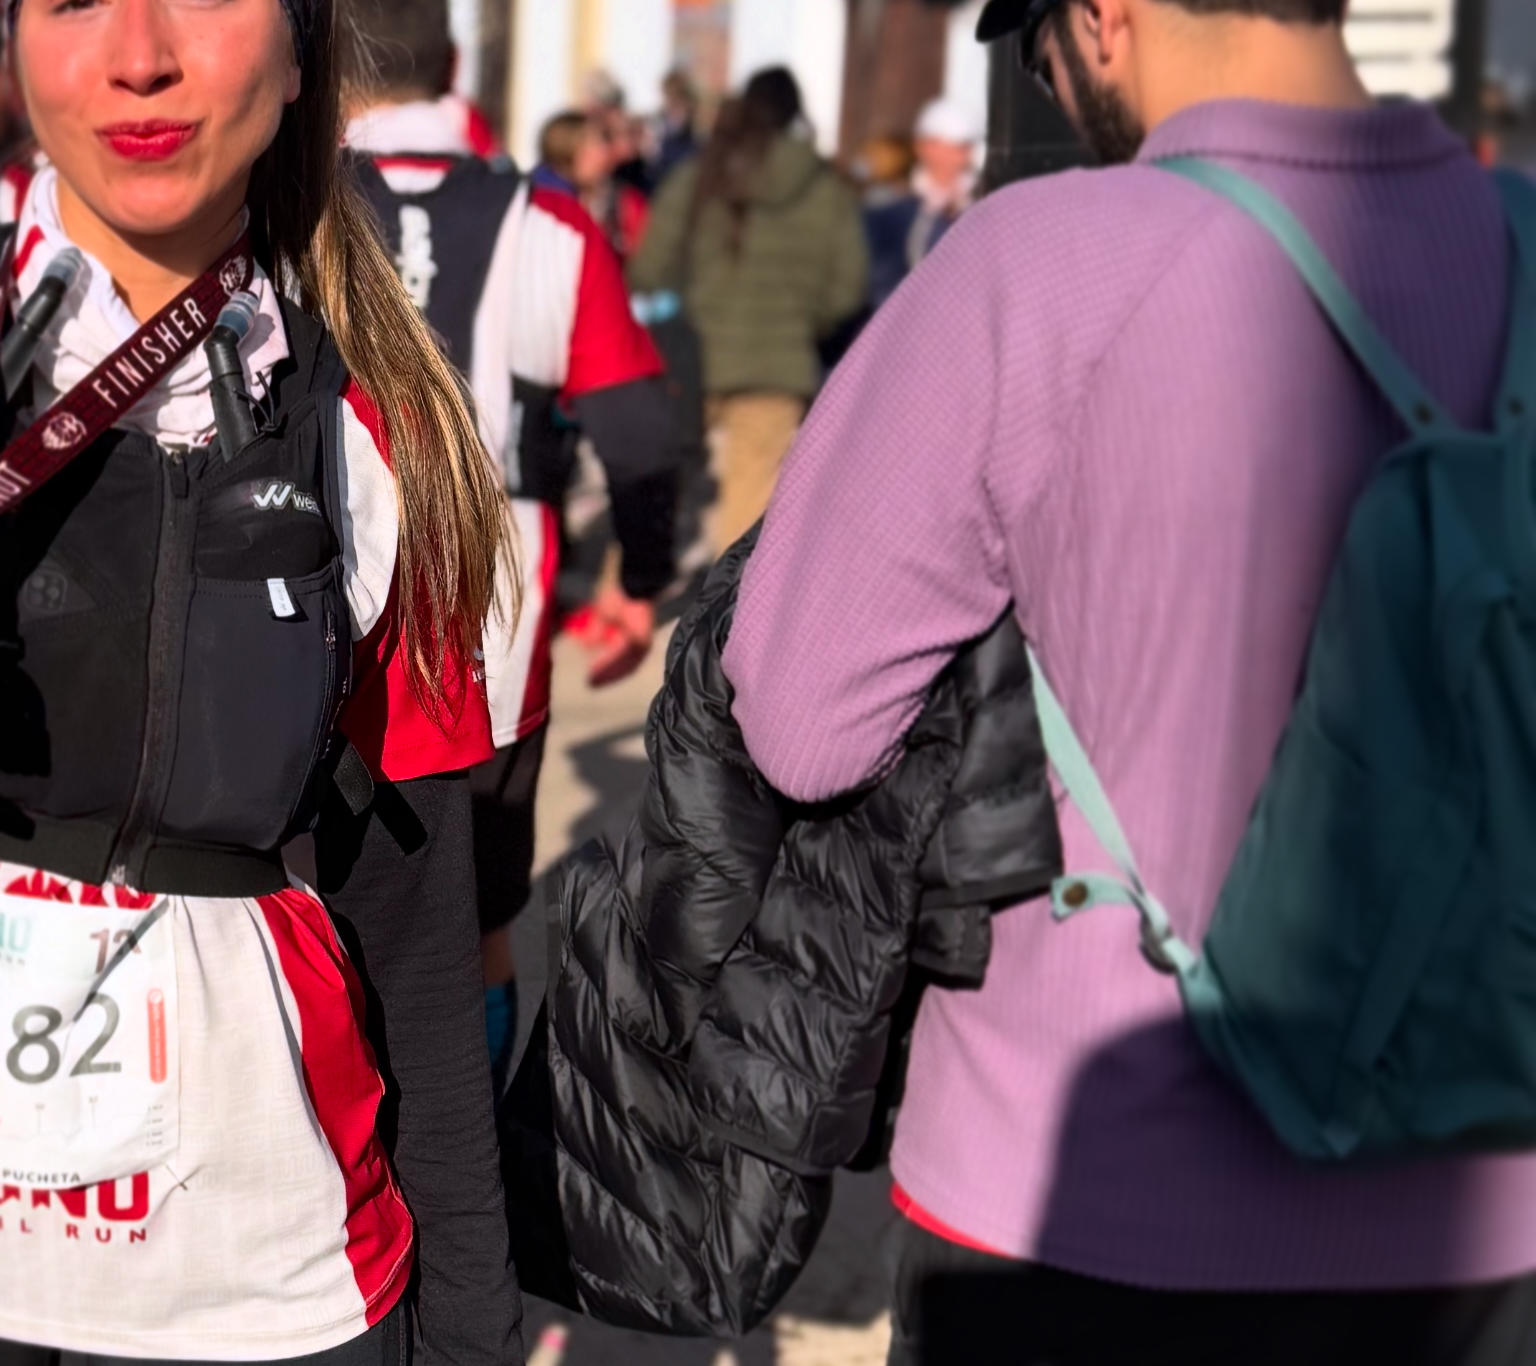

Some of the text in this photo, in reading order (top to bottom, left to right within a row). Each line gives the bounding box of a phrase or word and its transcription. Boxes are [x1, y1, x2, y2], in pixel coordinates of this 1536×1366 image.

[92, 297, 207, 408] FINISHER
[2, 1169, 81, 1184] PUCHETA
[66, 1223, 147, 1244] RUN
